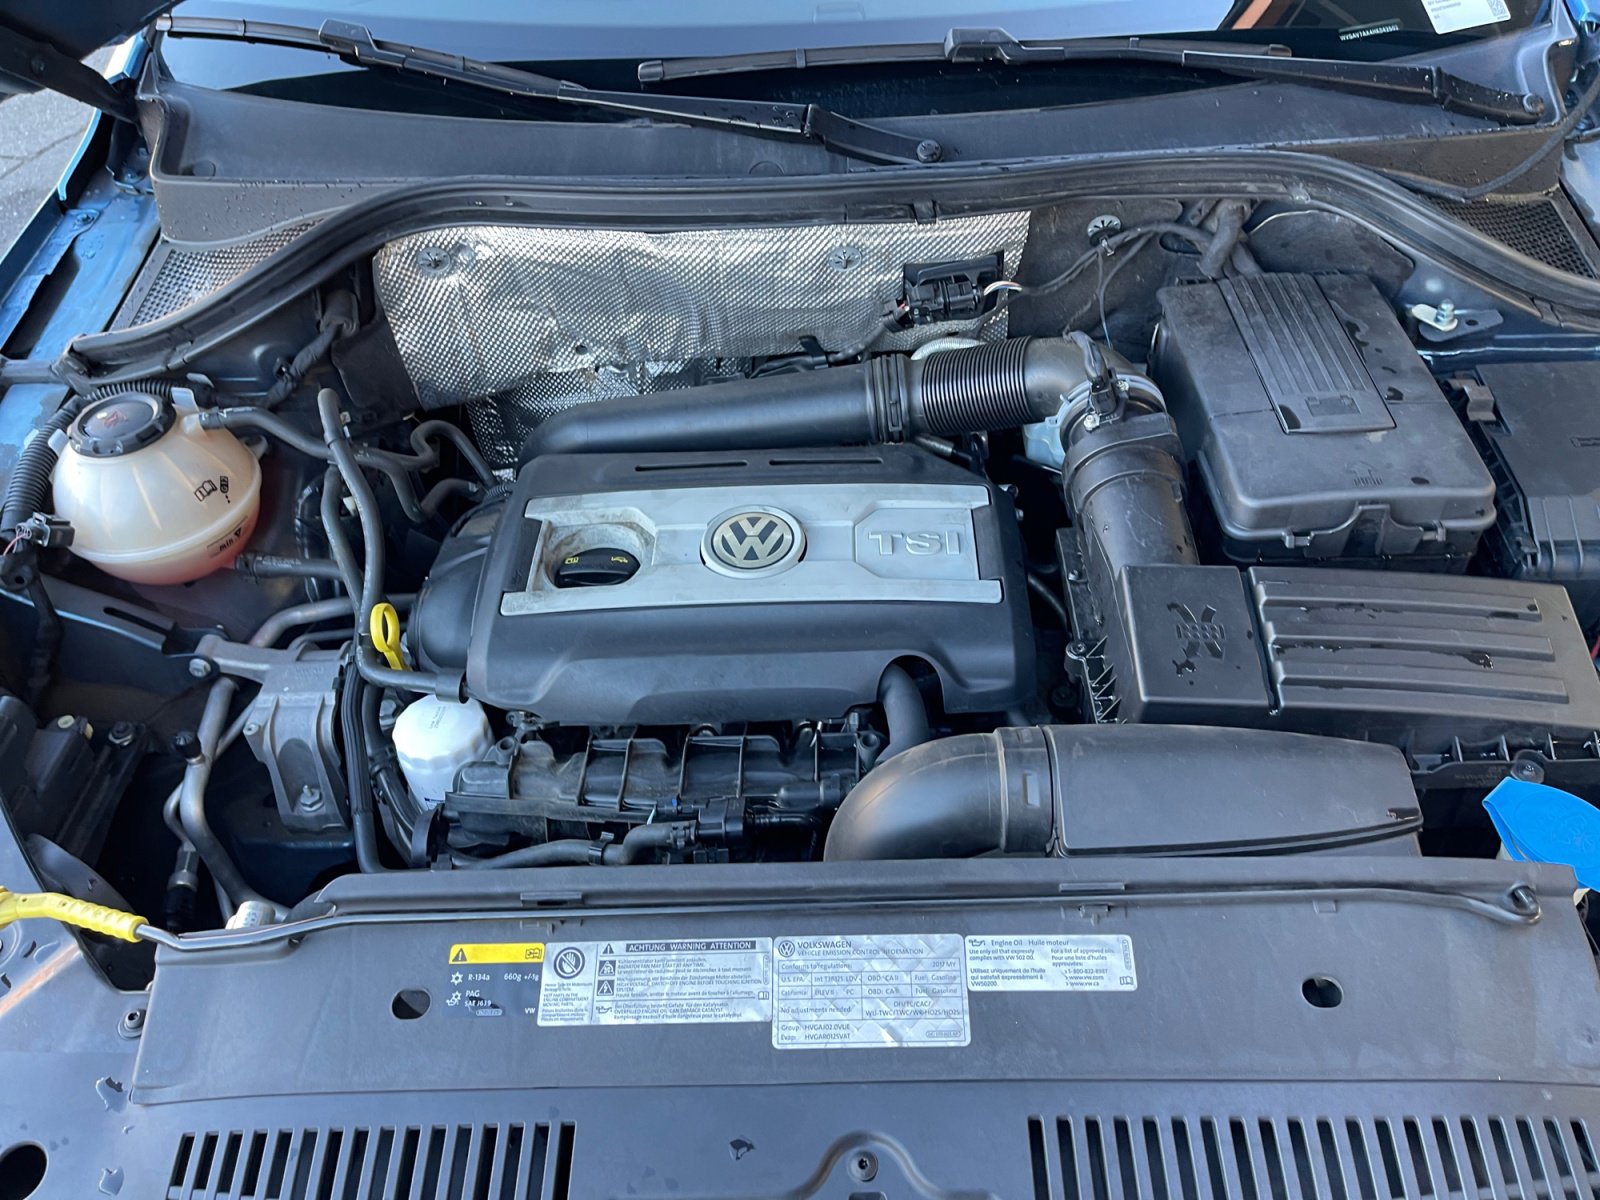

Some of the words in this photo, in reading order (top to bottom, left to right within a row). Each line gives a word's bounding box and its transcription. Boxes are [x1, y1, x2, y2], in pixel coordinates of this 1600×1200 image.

[219, 538, 234, 551] min
[867, 530, 962, 556] TSI
[628, 943, 666, 952] ACHTUNG
[670, 942, 706, 951] WARNING
[710, 942, 752, 950] ATTENTION
[797, 941, 852, 949] VOLKSWAGEN
[504, 973, 522, 982] 660g
